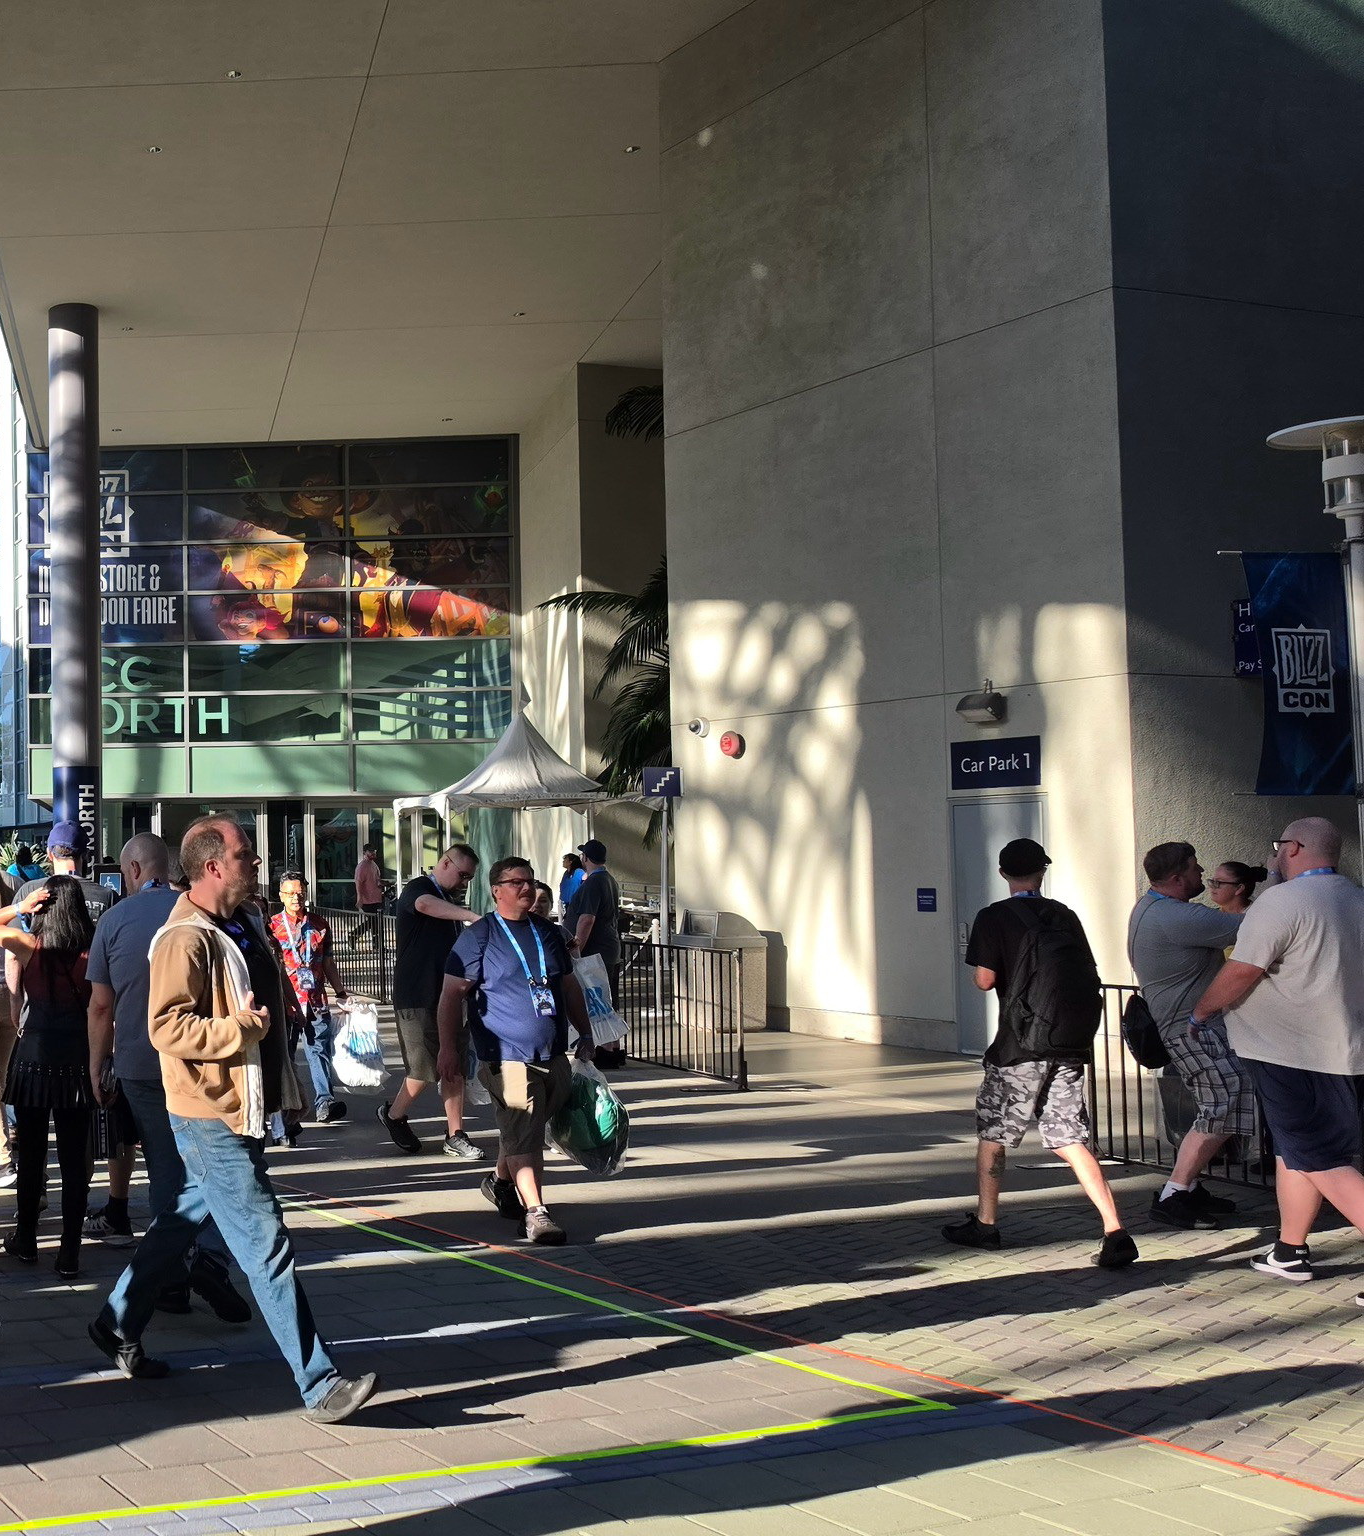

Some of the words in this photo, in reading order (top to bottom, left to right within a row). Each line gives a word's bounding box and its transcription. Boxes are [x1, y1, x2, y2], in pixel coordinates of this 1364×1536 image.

[100, 564, 146, 592] STORE
[149, 564, 161, 592] &
[133, 596, 177, 624] FAIRE
[1277, 634, 1329, 686] BLIZZ
[1283, 691, 1330, 709] CON
[100, 698, 230, 735] ORTH
[961, 758, 985, 773] Car
[989, 754, 1019, 771] Park
[1023, 753, 1030, 769] 1
